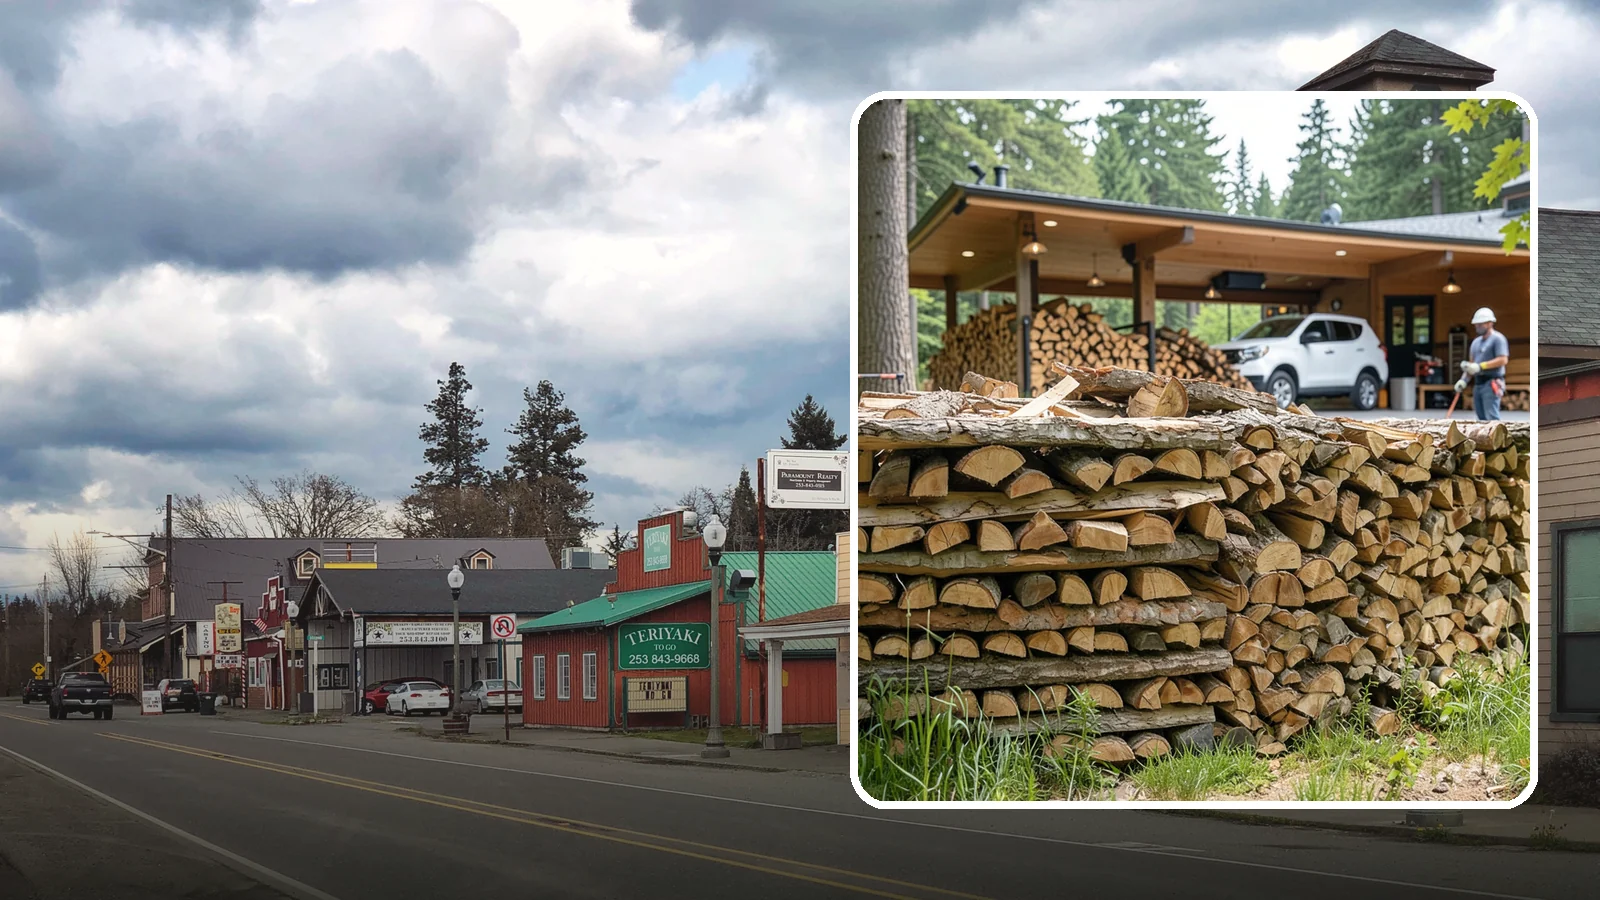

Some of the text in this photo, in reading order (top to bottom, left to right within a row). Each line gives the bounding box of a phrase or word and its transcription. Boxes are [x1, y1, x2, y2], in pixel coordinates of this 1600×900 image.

[781, 471, 839, 480] PARAMOUNT REALTY
[625, 627, 702, 646] TERIYAKI
[629, 653, 700, 664] 253 843-9668
